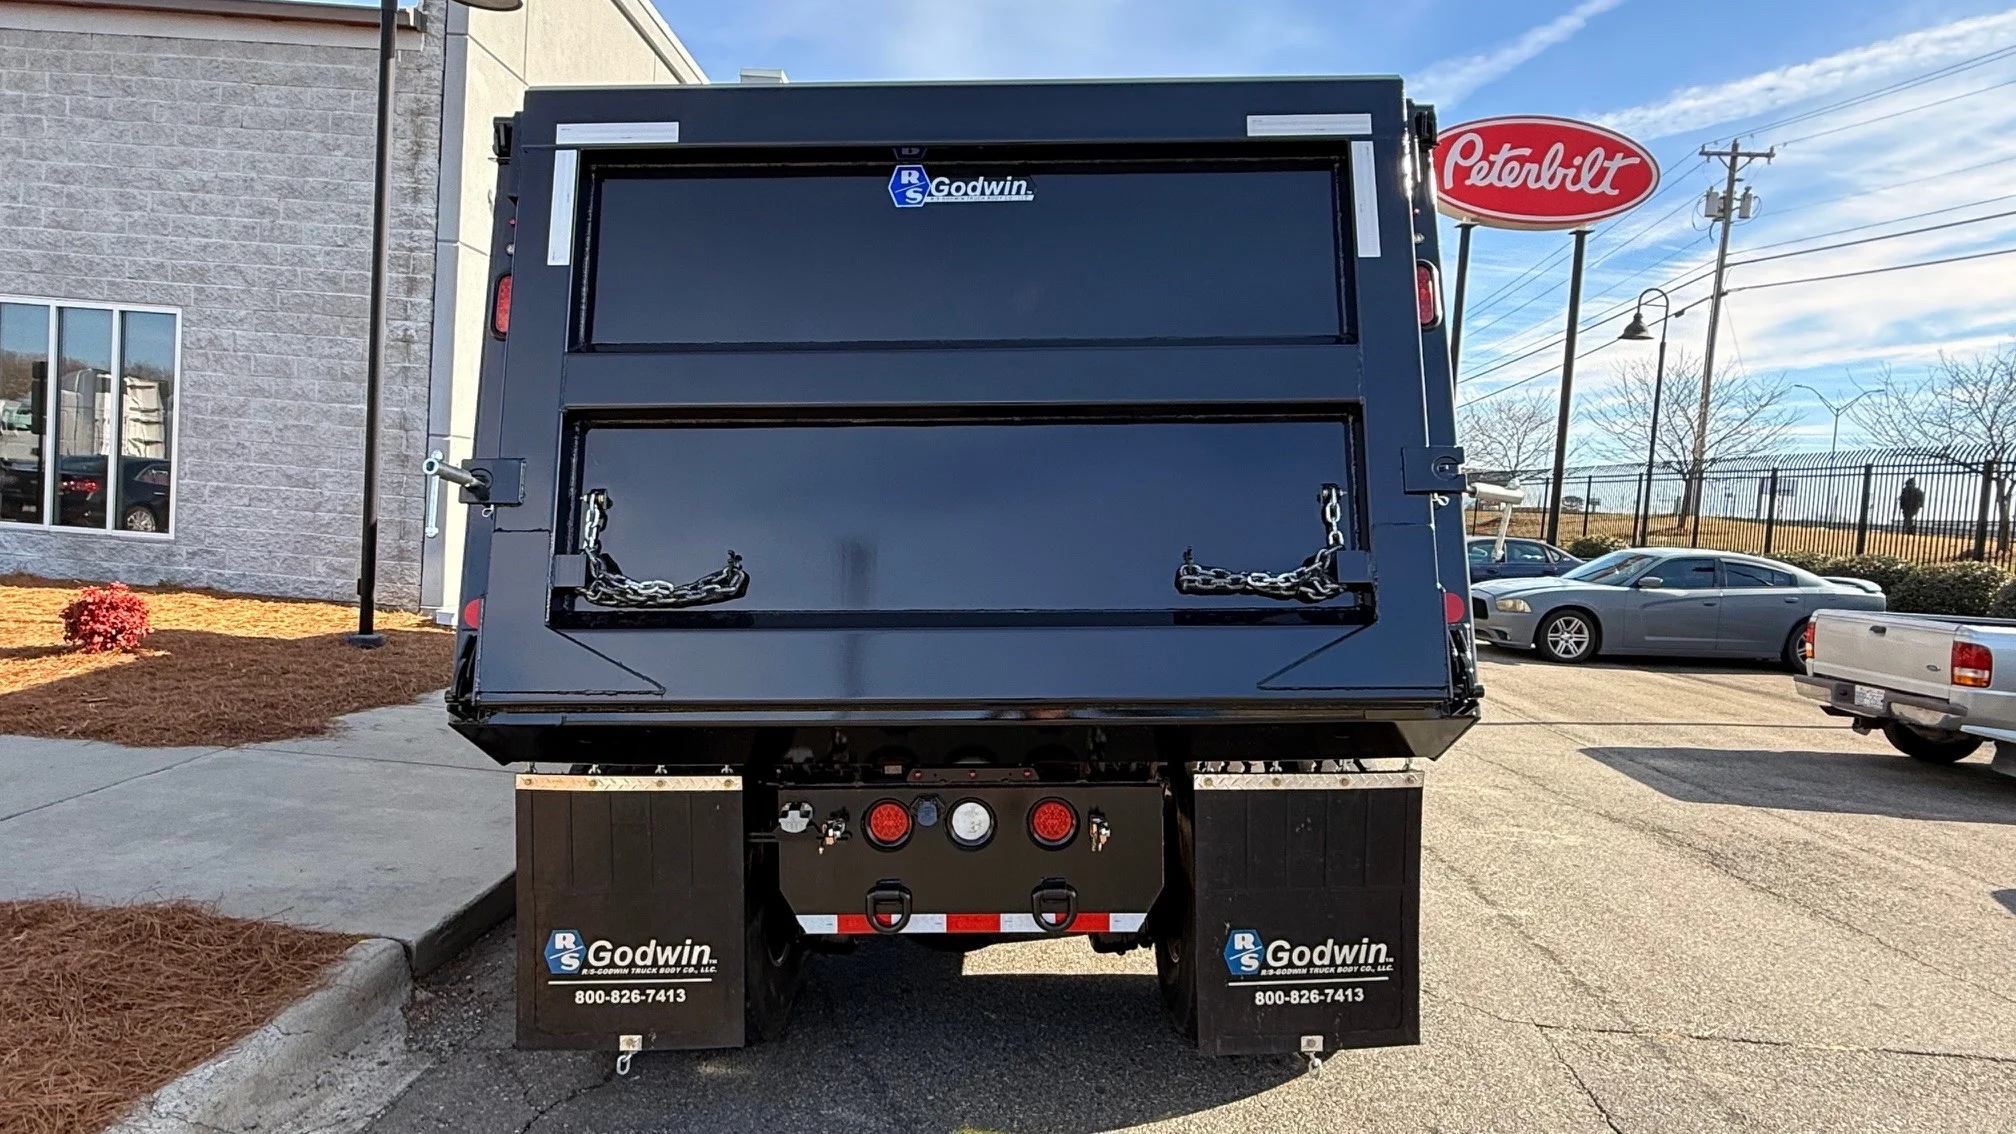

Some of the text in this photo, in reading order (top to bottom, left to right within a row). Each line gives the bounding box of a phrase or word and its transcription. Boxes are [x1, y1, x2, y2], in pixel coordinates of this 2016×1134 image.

[1444, 132, 1640, 196] Peterbilt
[930, 176, 1028, 197] Godwin
[587, 939, 711, 967] Godwin
[1266, 938, 1388, 967] Godwin
[631, 967, 658, 975] TRUCK
[659, 966, 681, 974] BODY
[1309, 966, 1336, 974] TRUCK
[1336, 965, 1359, 974] BODY
[575, 988, 687, 1005] 800-826-7413
[1254, 988, 1365, 1006] 800-826-7413
